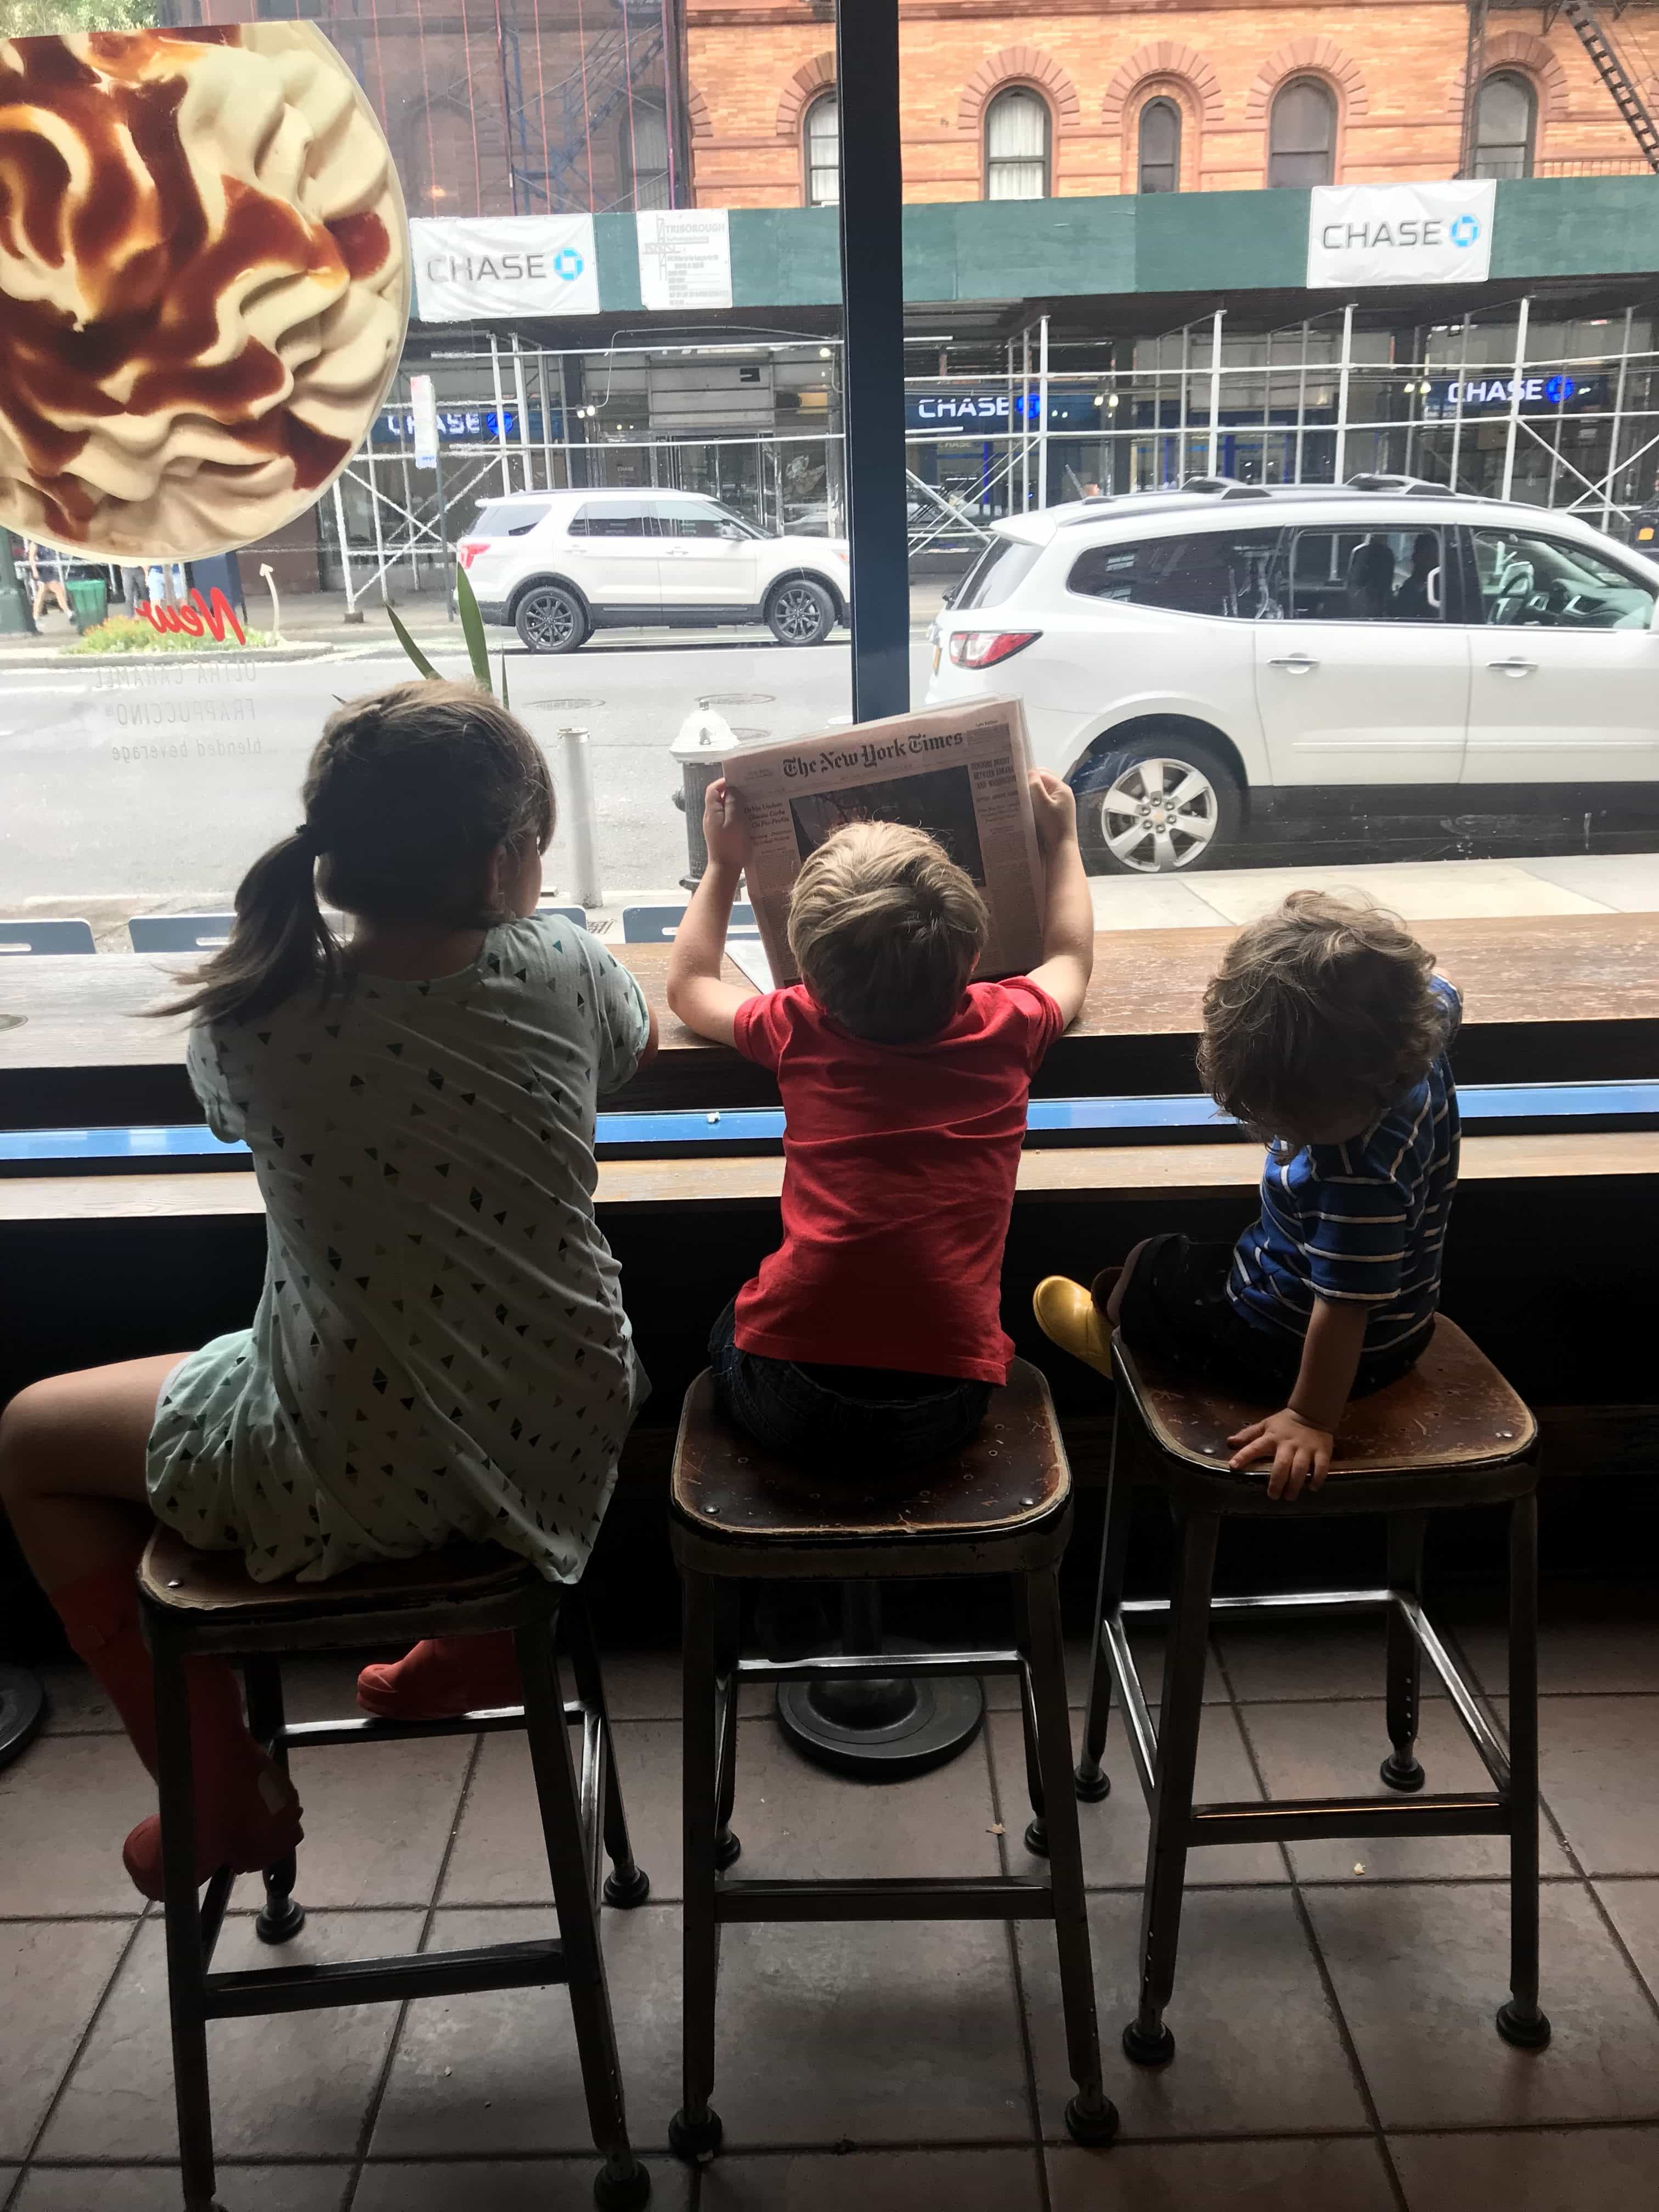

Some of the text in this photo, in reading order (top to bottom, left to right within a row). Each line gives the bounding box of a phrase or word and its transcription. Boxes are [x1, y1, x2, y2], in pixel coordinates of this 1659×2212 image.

[665, 223, 725, 233] TRIBOROUGH
[1323, 219, 1443, 249] CHASE
[426, 253, 547, 281] CHASE
[1448, 379, 1544, 403] CHASE
[918, 397, 1010, 418] CHASE
[783, 756, 817, 777] The
[820, 751, 859, 773] New
[861, 738, 907, 768] York
[908, 733, 963, 754] Times
